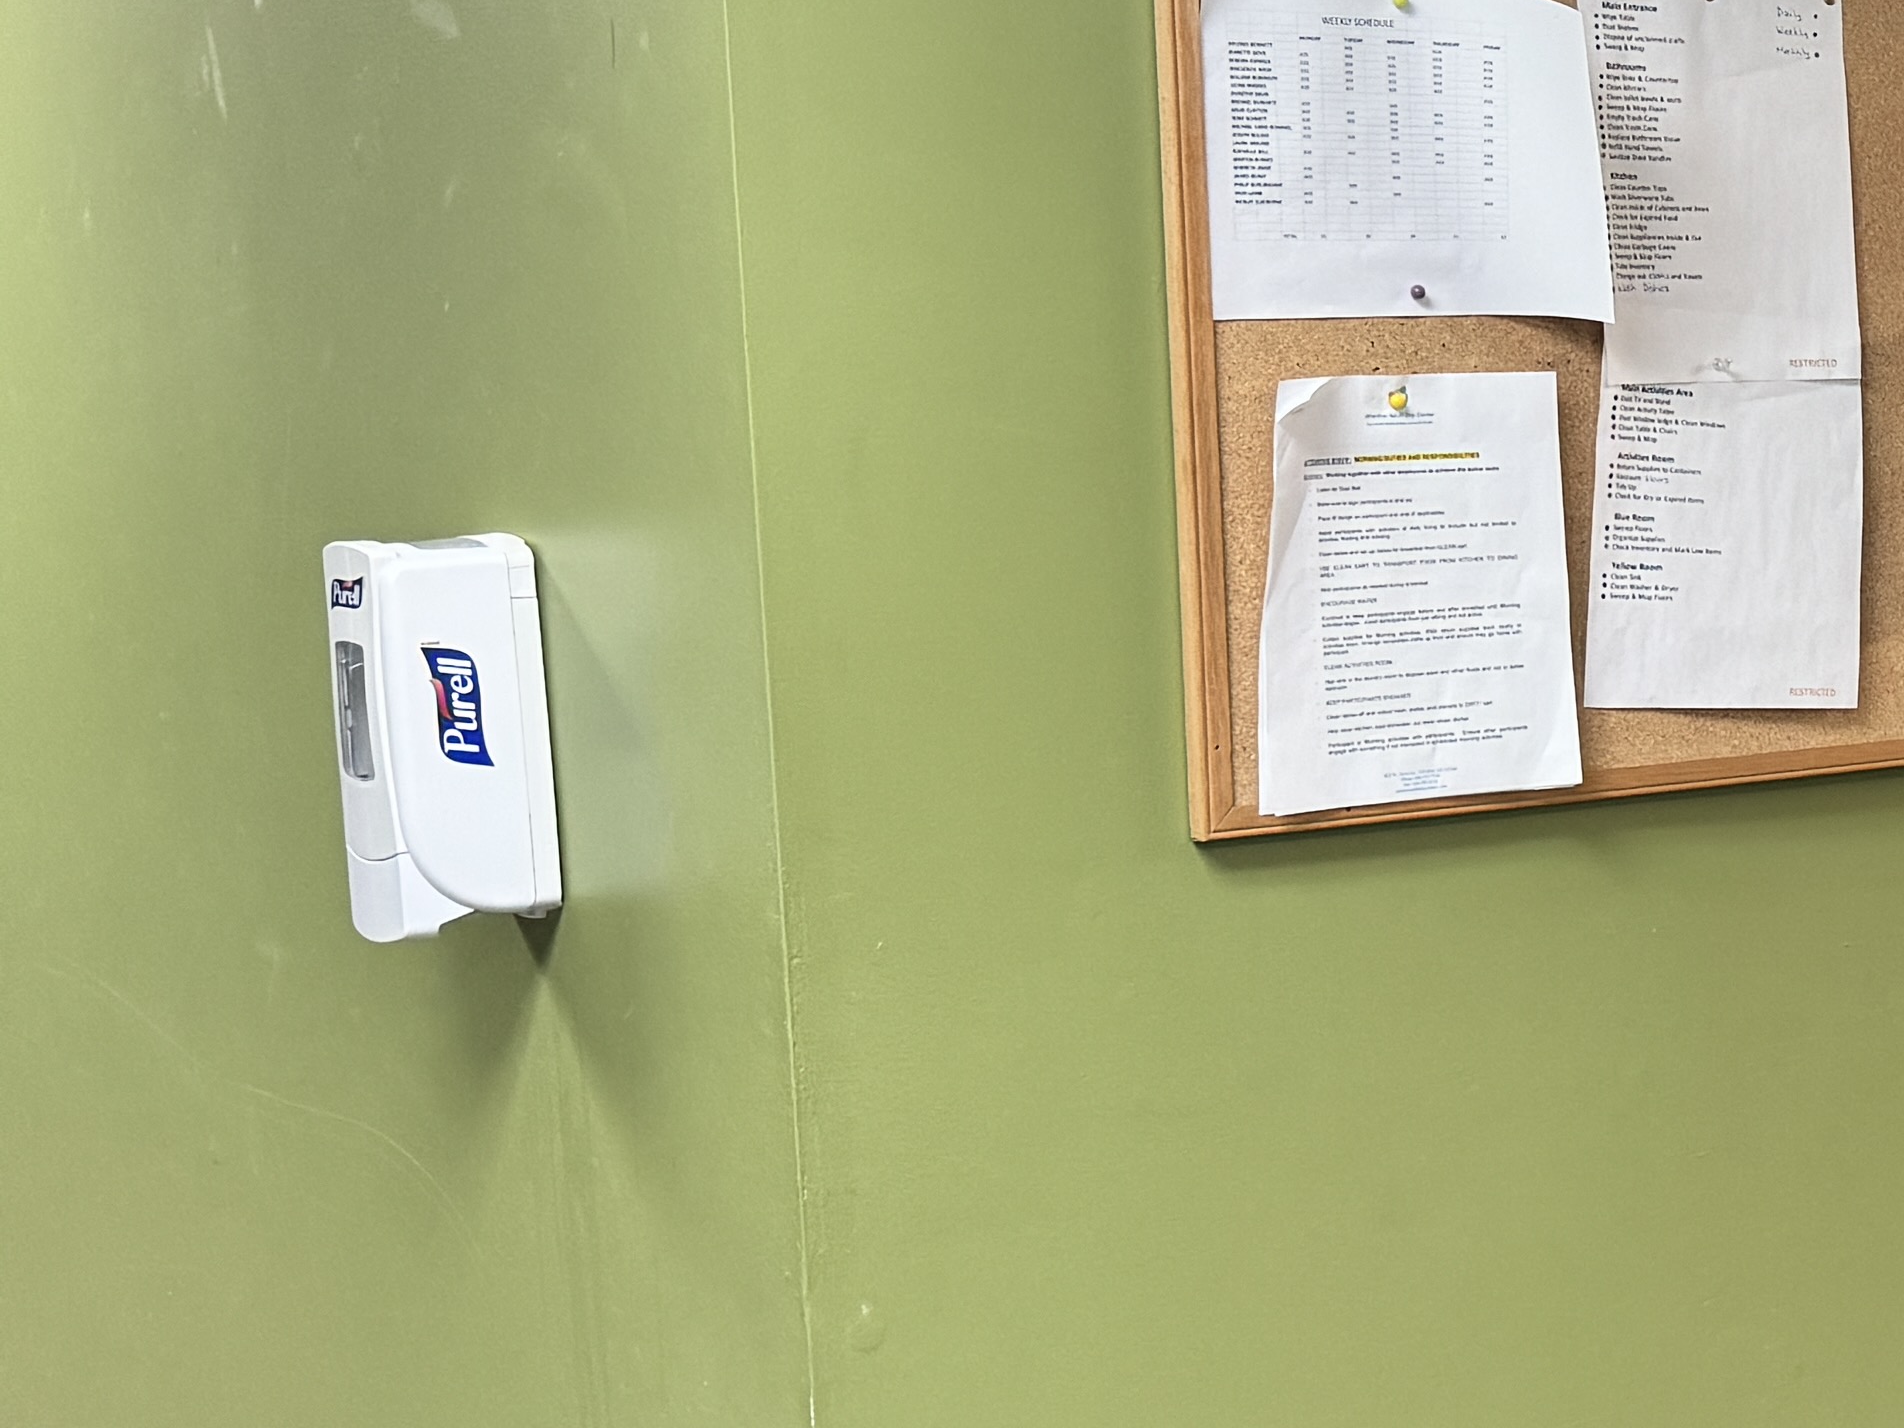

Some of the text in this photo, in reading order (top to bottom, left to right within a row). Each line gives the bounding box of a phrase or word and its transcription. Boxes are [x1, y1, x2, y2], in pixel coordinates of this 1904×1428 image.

[1790, 359, 1837, 367] RESTRICTED
[333, 581, 360, 606] Purell
[1790, 688, 1836, 696] RESTRICTED
[436, 657, 480, 753] Purell
